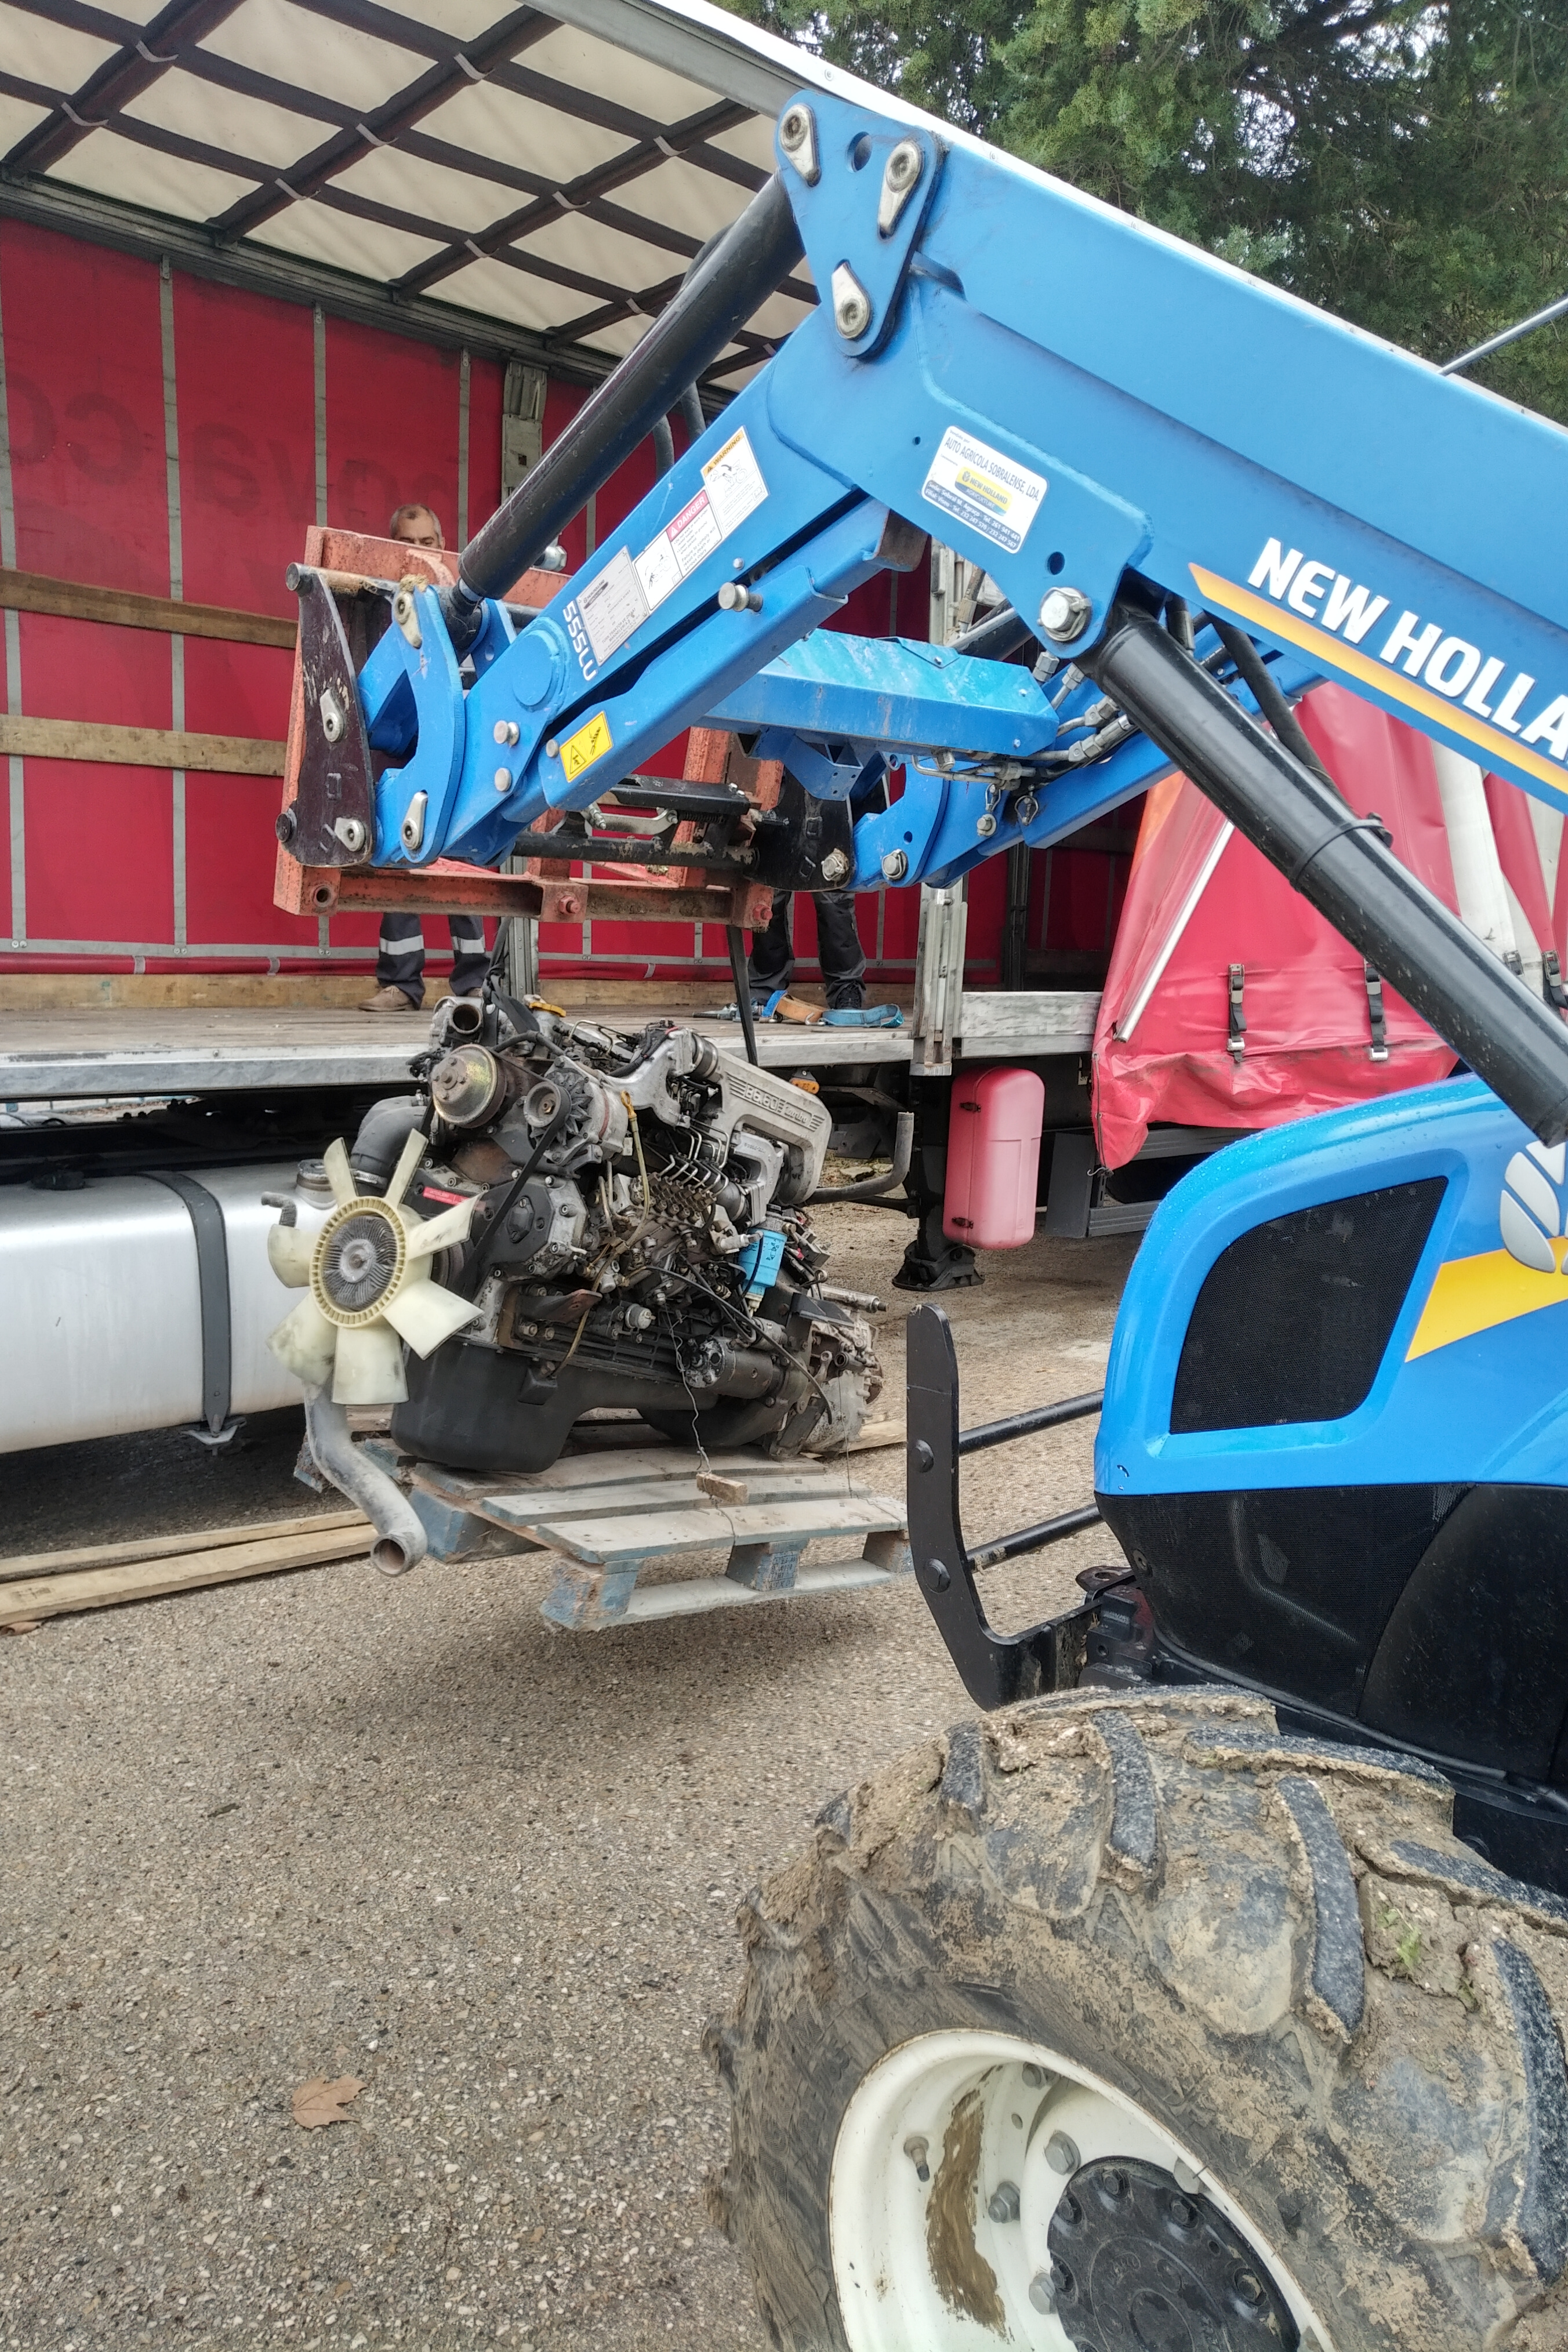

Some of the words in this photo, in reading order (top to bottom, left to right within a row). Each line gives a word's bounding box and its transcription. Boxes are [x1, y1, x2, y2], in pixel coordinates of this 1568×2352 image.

[713, 435, 740, 465] WARNING
[944, 437, 961, 453] AUTO
[960, 446, 989, 470] AGRÍCOLA
[988, 462, 1026, 494] SOBRALENSE,
[1025, 485, 1039, 502] LDA.
[677, 496, 705, 528] DANGER
[928, 481, 941, 492] Sede:
[941, 489, 957, 502] Sobral
[983, 515, 991, 524] Tel.
[991, 521, 1001, 529] 261
[1001, 526, 1010, 536] 941
[1010, 532, 1020, 542] 441
[966, 488, 995, 509] AGRICULTURE
[970, 477, 983, 491] NEW
[982, 485, 1008, 504] HOLLAND
[925, 489, 938, 498] Filial:
[938, 496, 950, 507] Viseu
[952, 504, 960, 513] Tel.
[969, 516, 979, 524] 247
[989, 528, 999, 538] 232
[998, 534, 1008, 542] 247
[1007, 539, 1017, 548] 567
[682, 549, 692, 561] Failure
[697, 533, 709, 546] comply
[562, 600, 598, 681] 555LU
[1247, 537, 1391, 644] NEW
[1380, 609, 1568, 761] HOLLA
